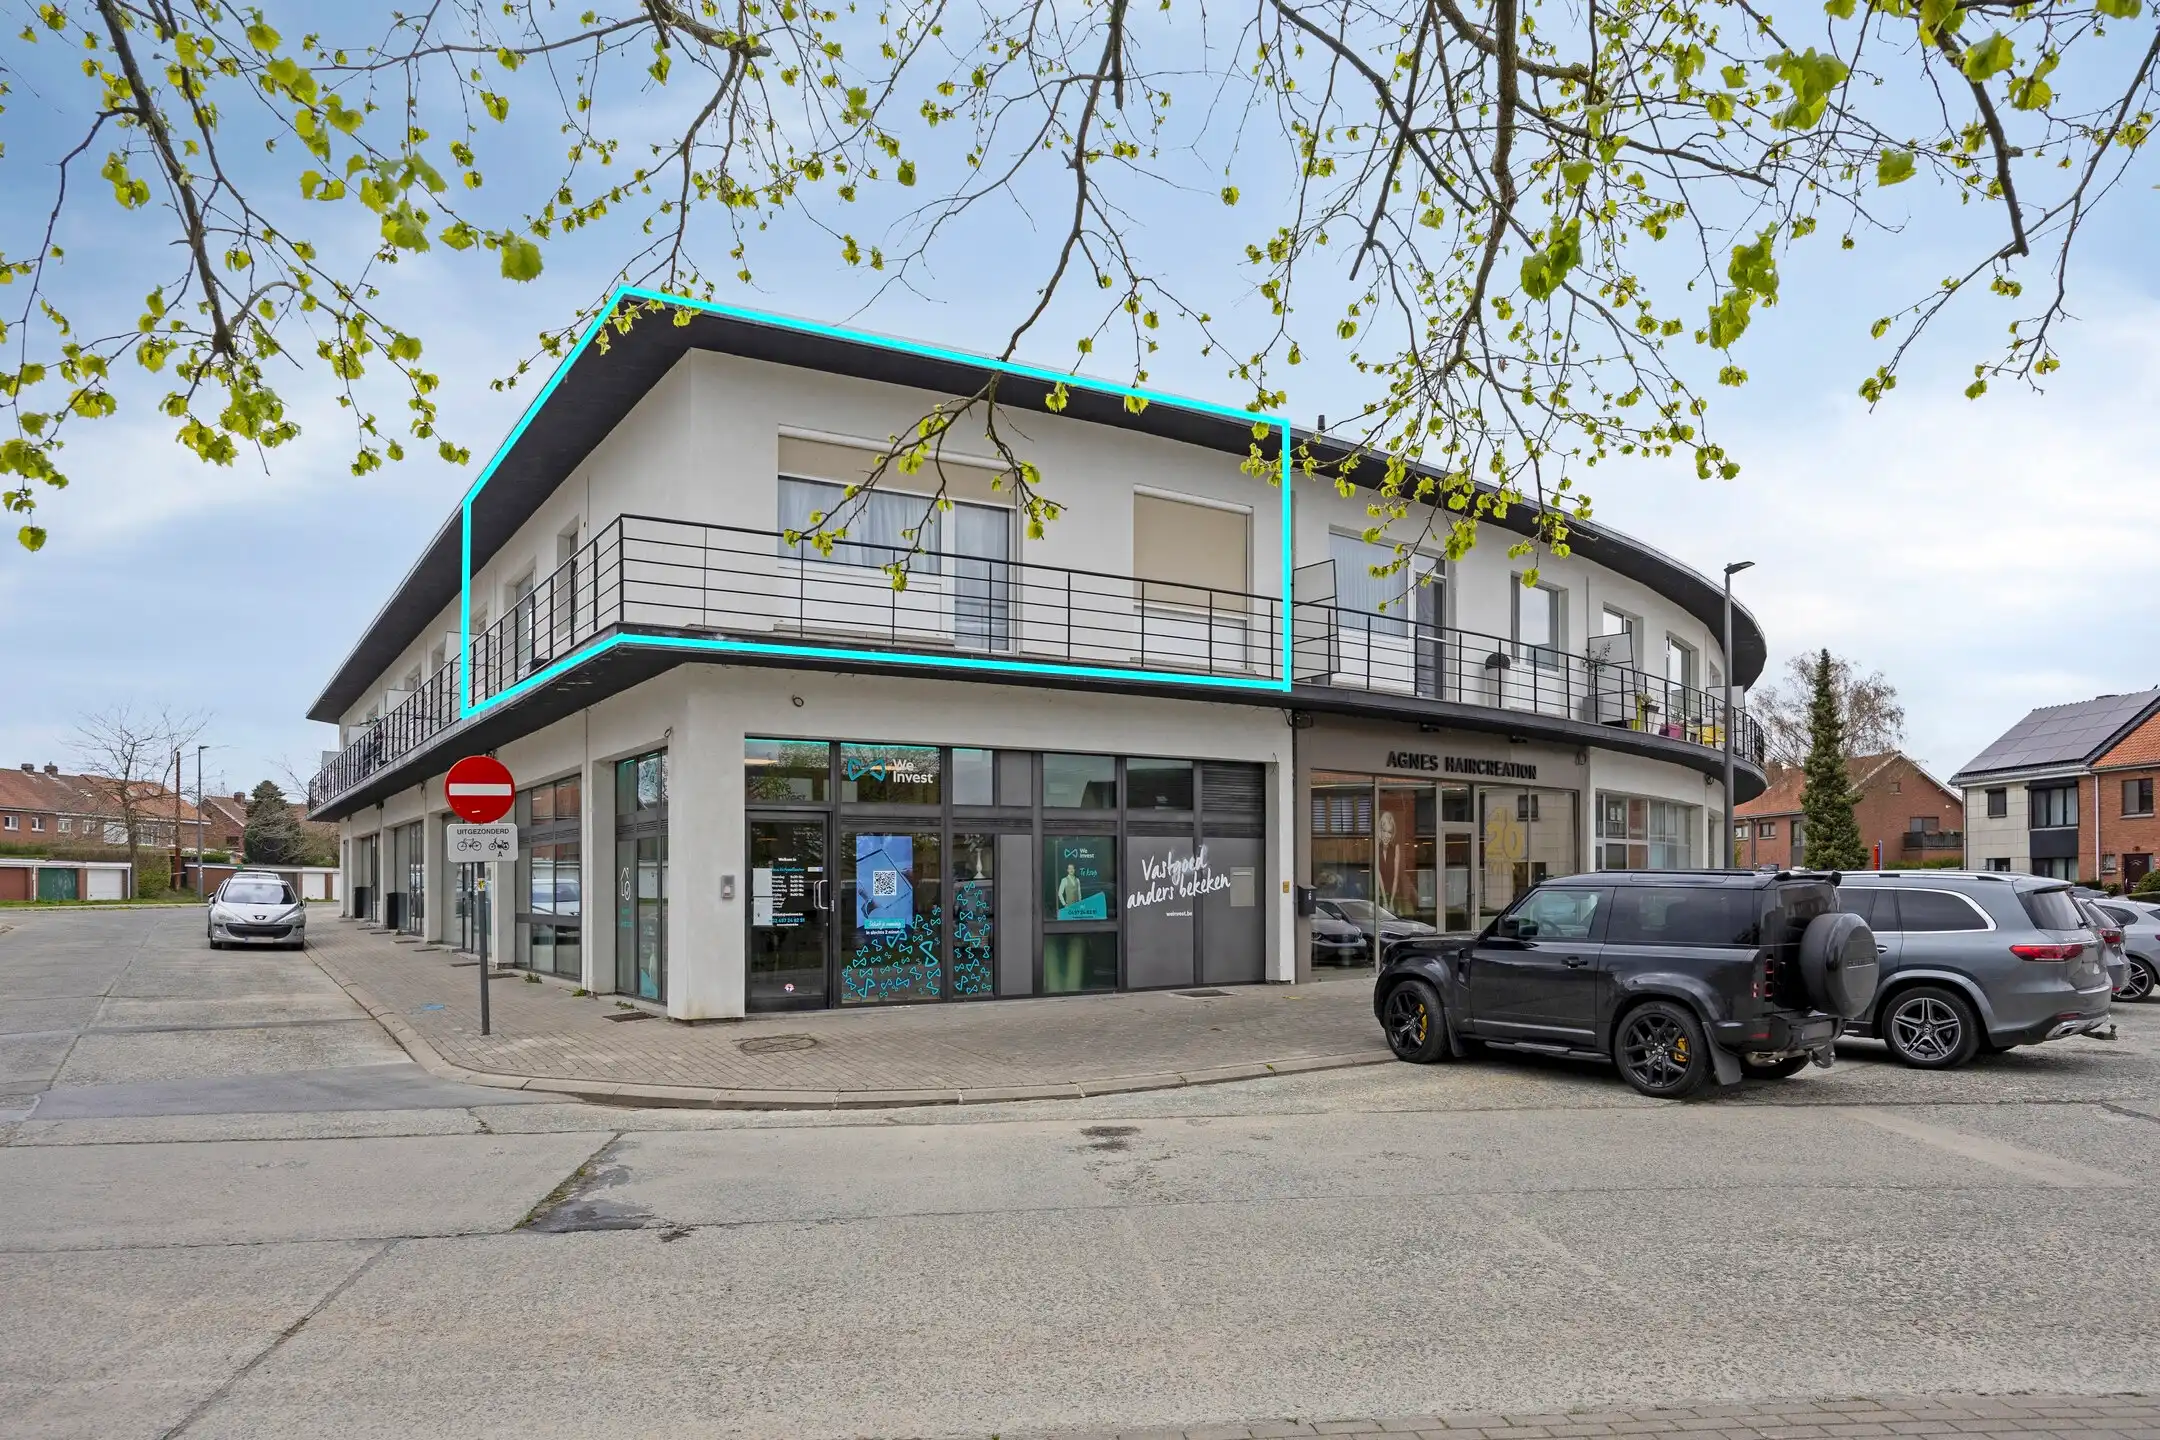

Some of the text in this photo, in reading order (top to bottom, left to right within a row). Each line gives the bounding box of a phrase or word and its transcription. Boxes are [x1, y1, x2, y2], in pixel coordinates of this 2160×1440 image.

[893, 758, 915, 771] We
[893, 771, 934, 784] Invest
[1386, 751, 1537, 780] AGNES HAIRCREATION
[1142, 844, 1208, 886] Vastgoed
[1127, 867, 1231, 909] anders bekeken
